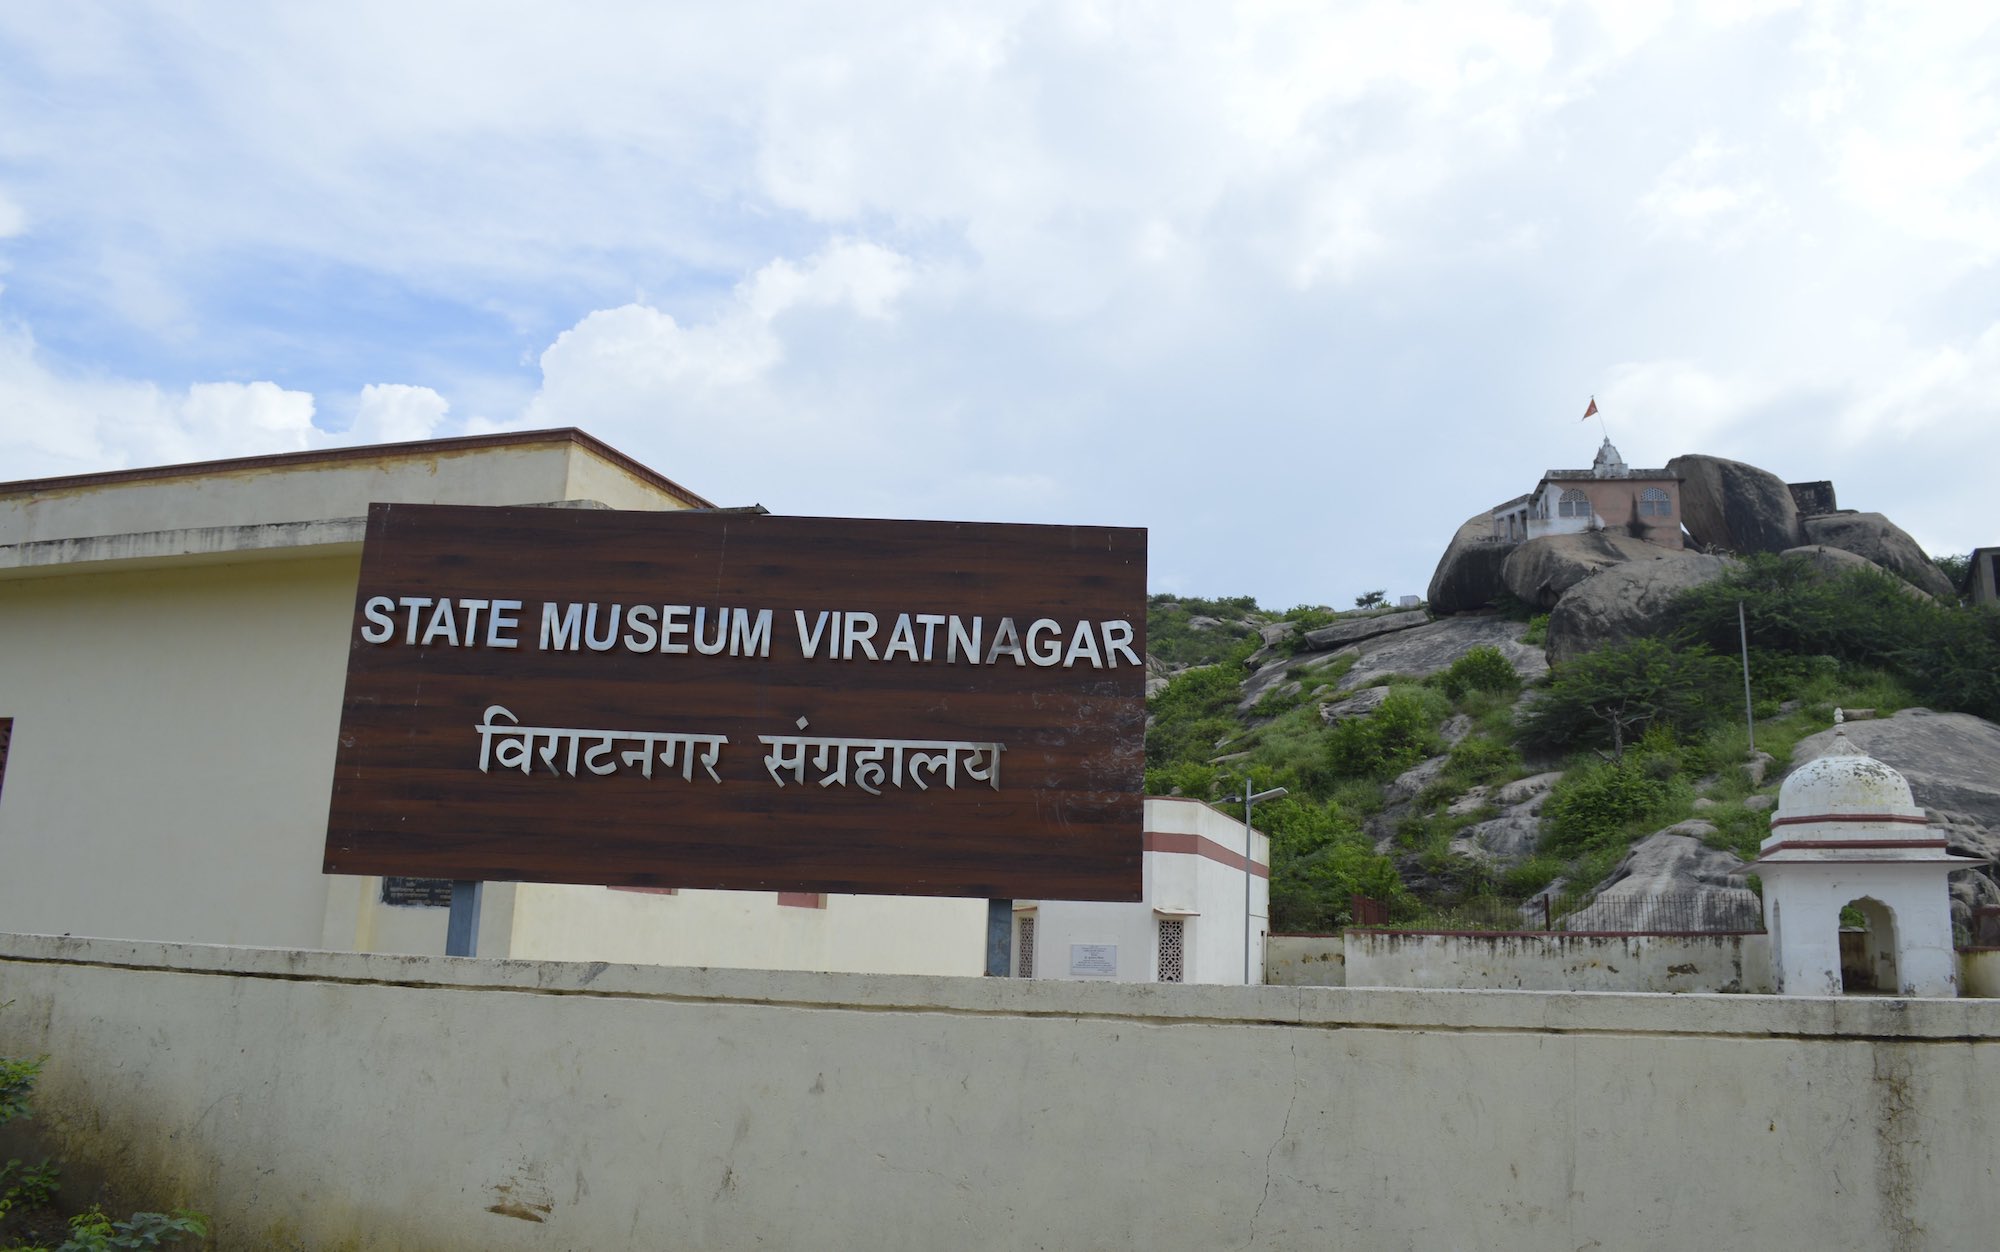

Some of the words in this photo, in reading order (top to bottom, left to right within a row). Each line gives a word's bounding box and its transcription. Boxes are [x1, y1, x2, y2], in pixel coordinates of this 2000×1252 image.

[361, 596, 522, 648] STATE
[538, 602, 773, 658] MUSEUM
[794, 609, 1142, 669] VIRATNAGAR
[474, 704, 729, 784] विराटनगर
[757, 715, 1007, 795] संग्रहालय
